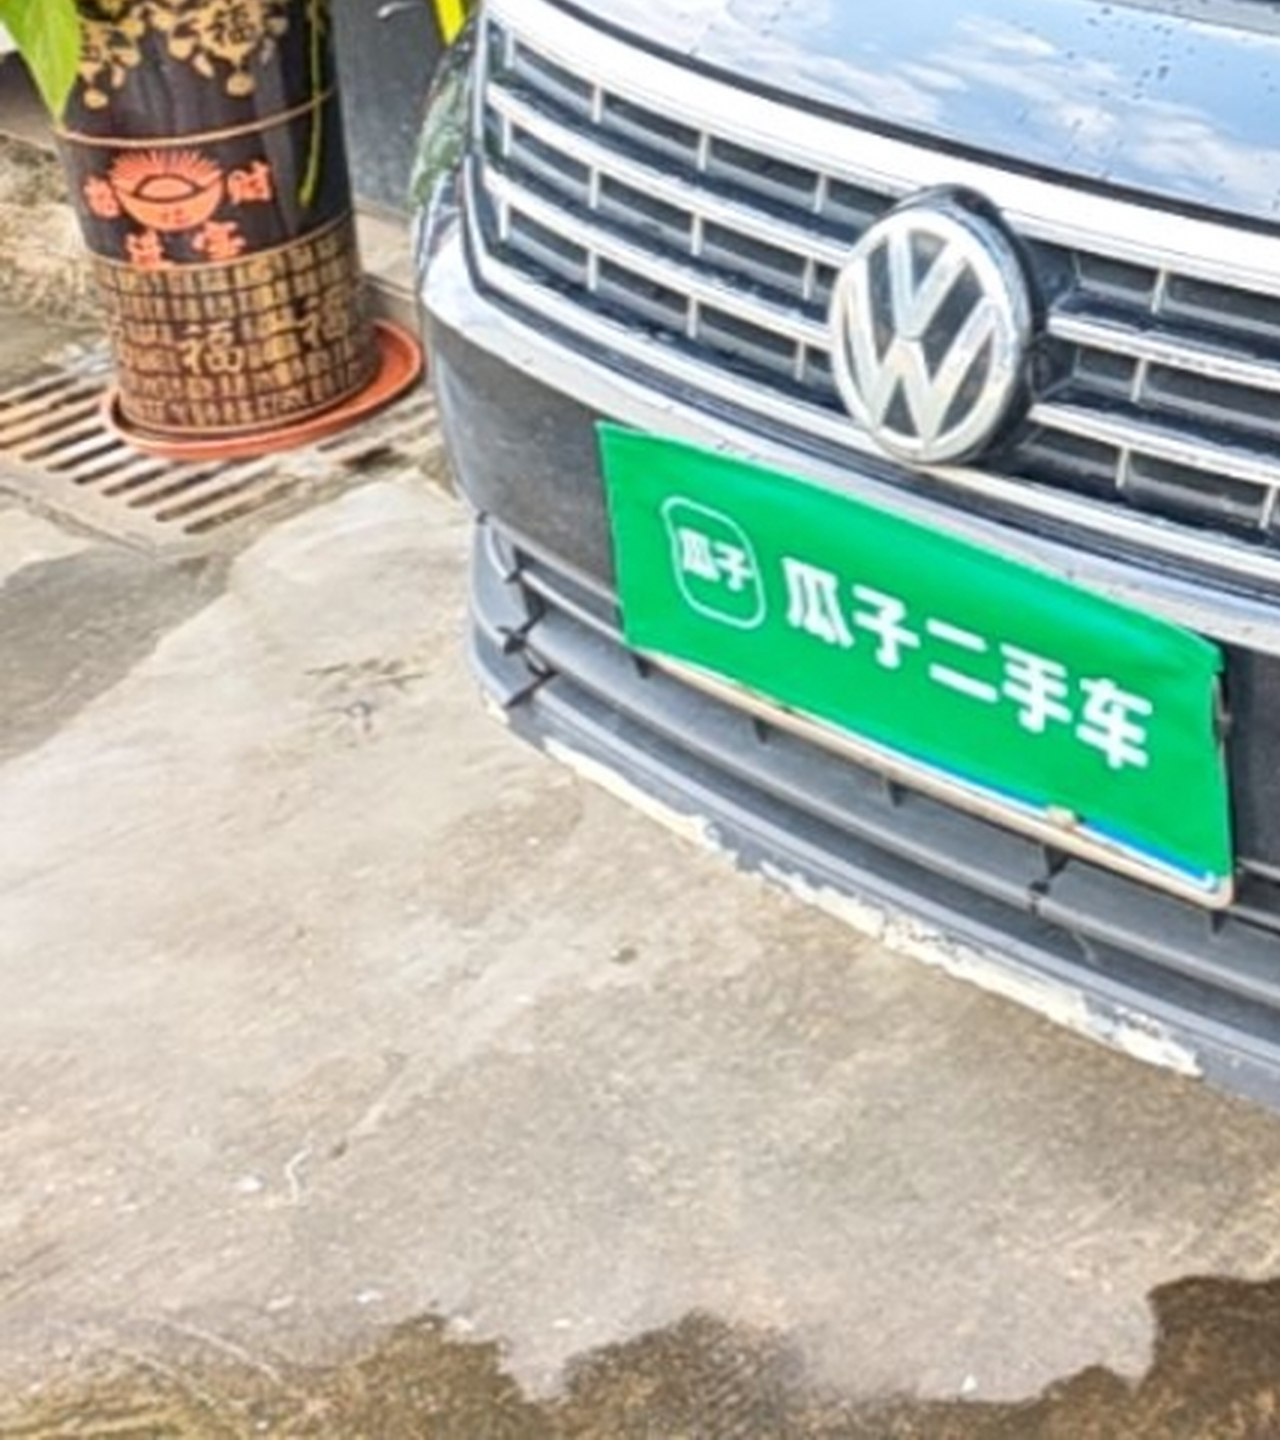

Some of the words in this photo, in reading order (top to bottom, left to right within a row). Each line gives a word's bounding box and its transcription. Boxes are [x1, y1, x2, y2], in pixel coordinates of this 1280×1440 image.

[678, 526, 756, 591] 瓜子
[781, 554, 1154, 770] 瓜子二手车
